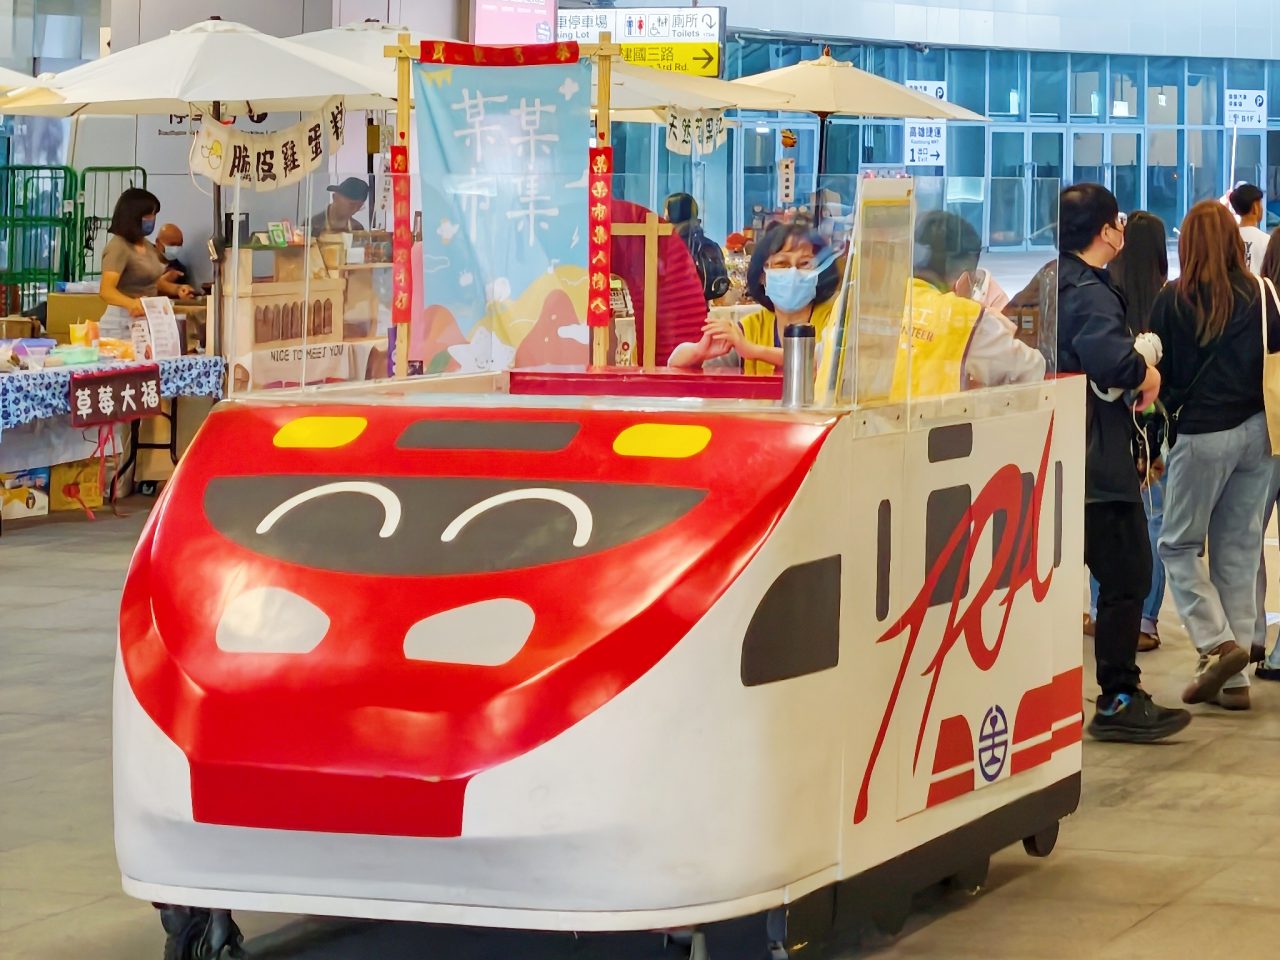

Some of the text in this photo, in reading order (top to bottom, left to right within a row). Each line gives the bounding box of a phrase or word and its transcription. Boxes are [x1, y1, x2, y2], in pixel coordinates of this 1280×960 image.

[671, 13, 698, 28] 廁所
[575, 30, 590, 39] Lot
[672, 29, 700, 38] Toilets
[271, 349, 289, 362] NICE
[329, 343, 344, 357] YOU
[75, 380, 160, 420] 草莓大福
